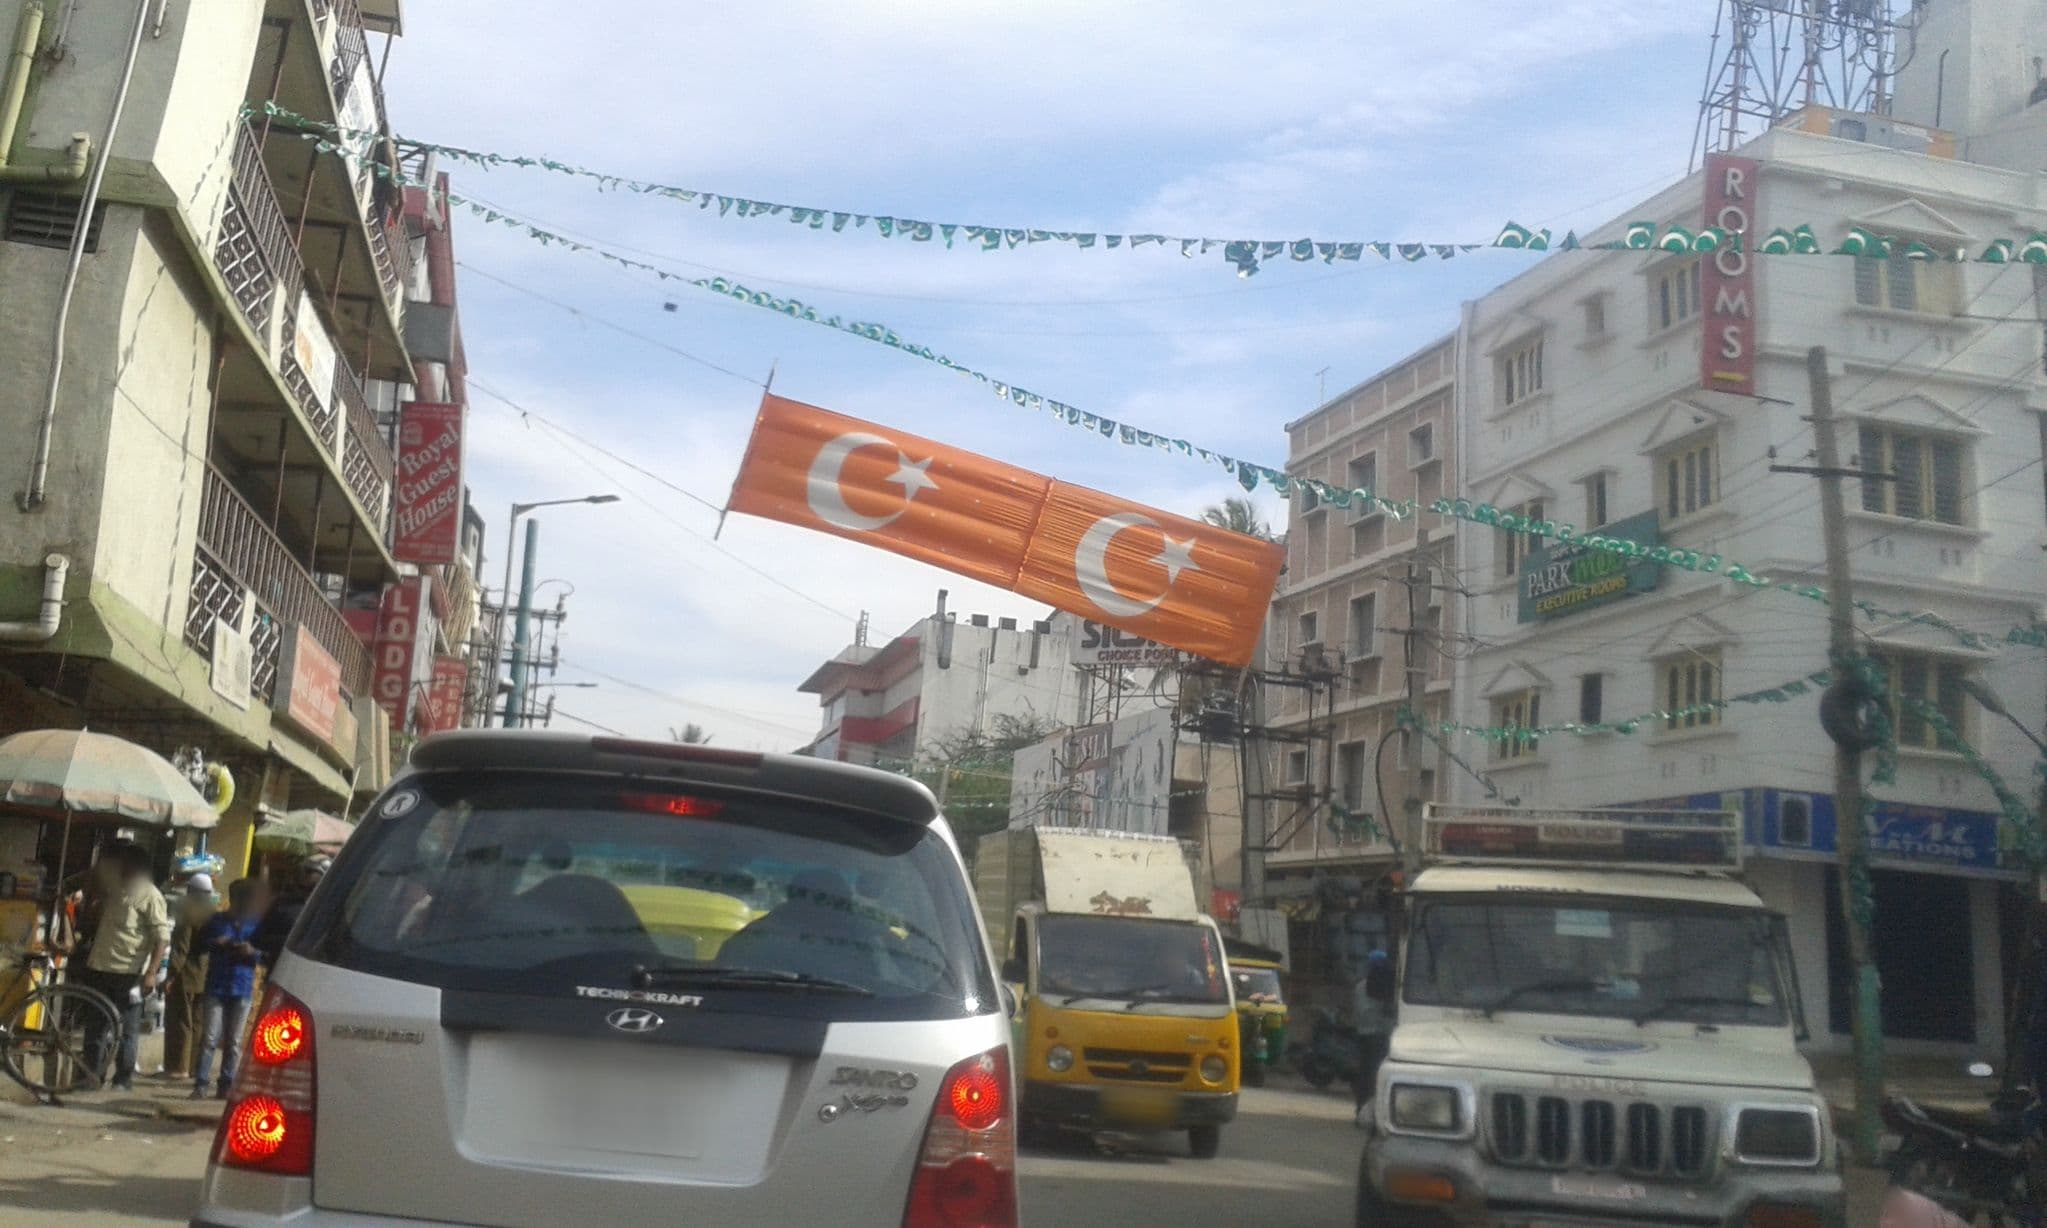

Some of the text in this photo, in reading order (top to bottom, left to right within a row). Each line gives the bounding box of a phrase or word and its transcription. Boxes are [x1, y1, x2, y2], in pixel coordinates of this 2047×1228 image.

[1715, 167, 1750, 360] ROOMS
[401, 421, 460, 476] Royal
[400, 456, 458, 506] Guest
[399, 485, 458, 537] House
[1526, 560, 1574, 599] PARK
[1097, 649, 1142, 662] CHOICE
